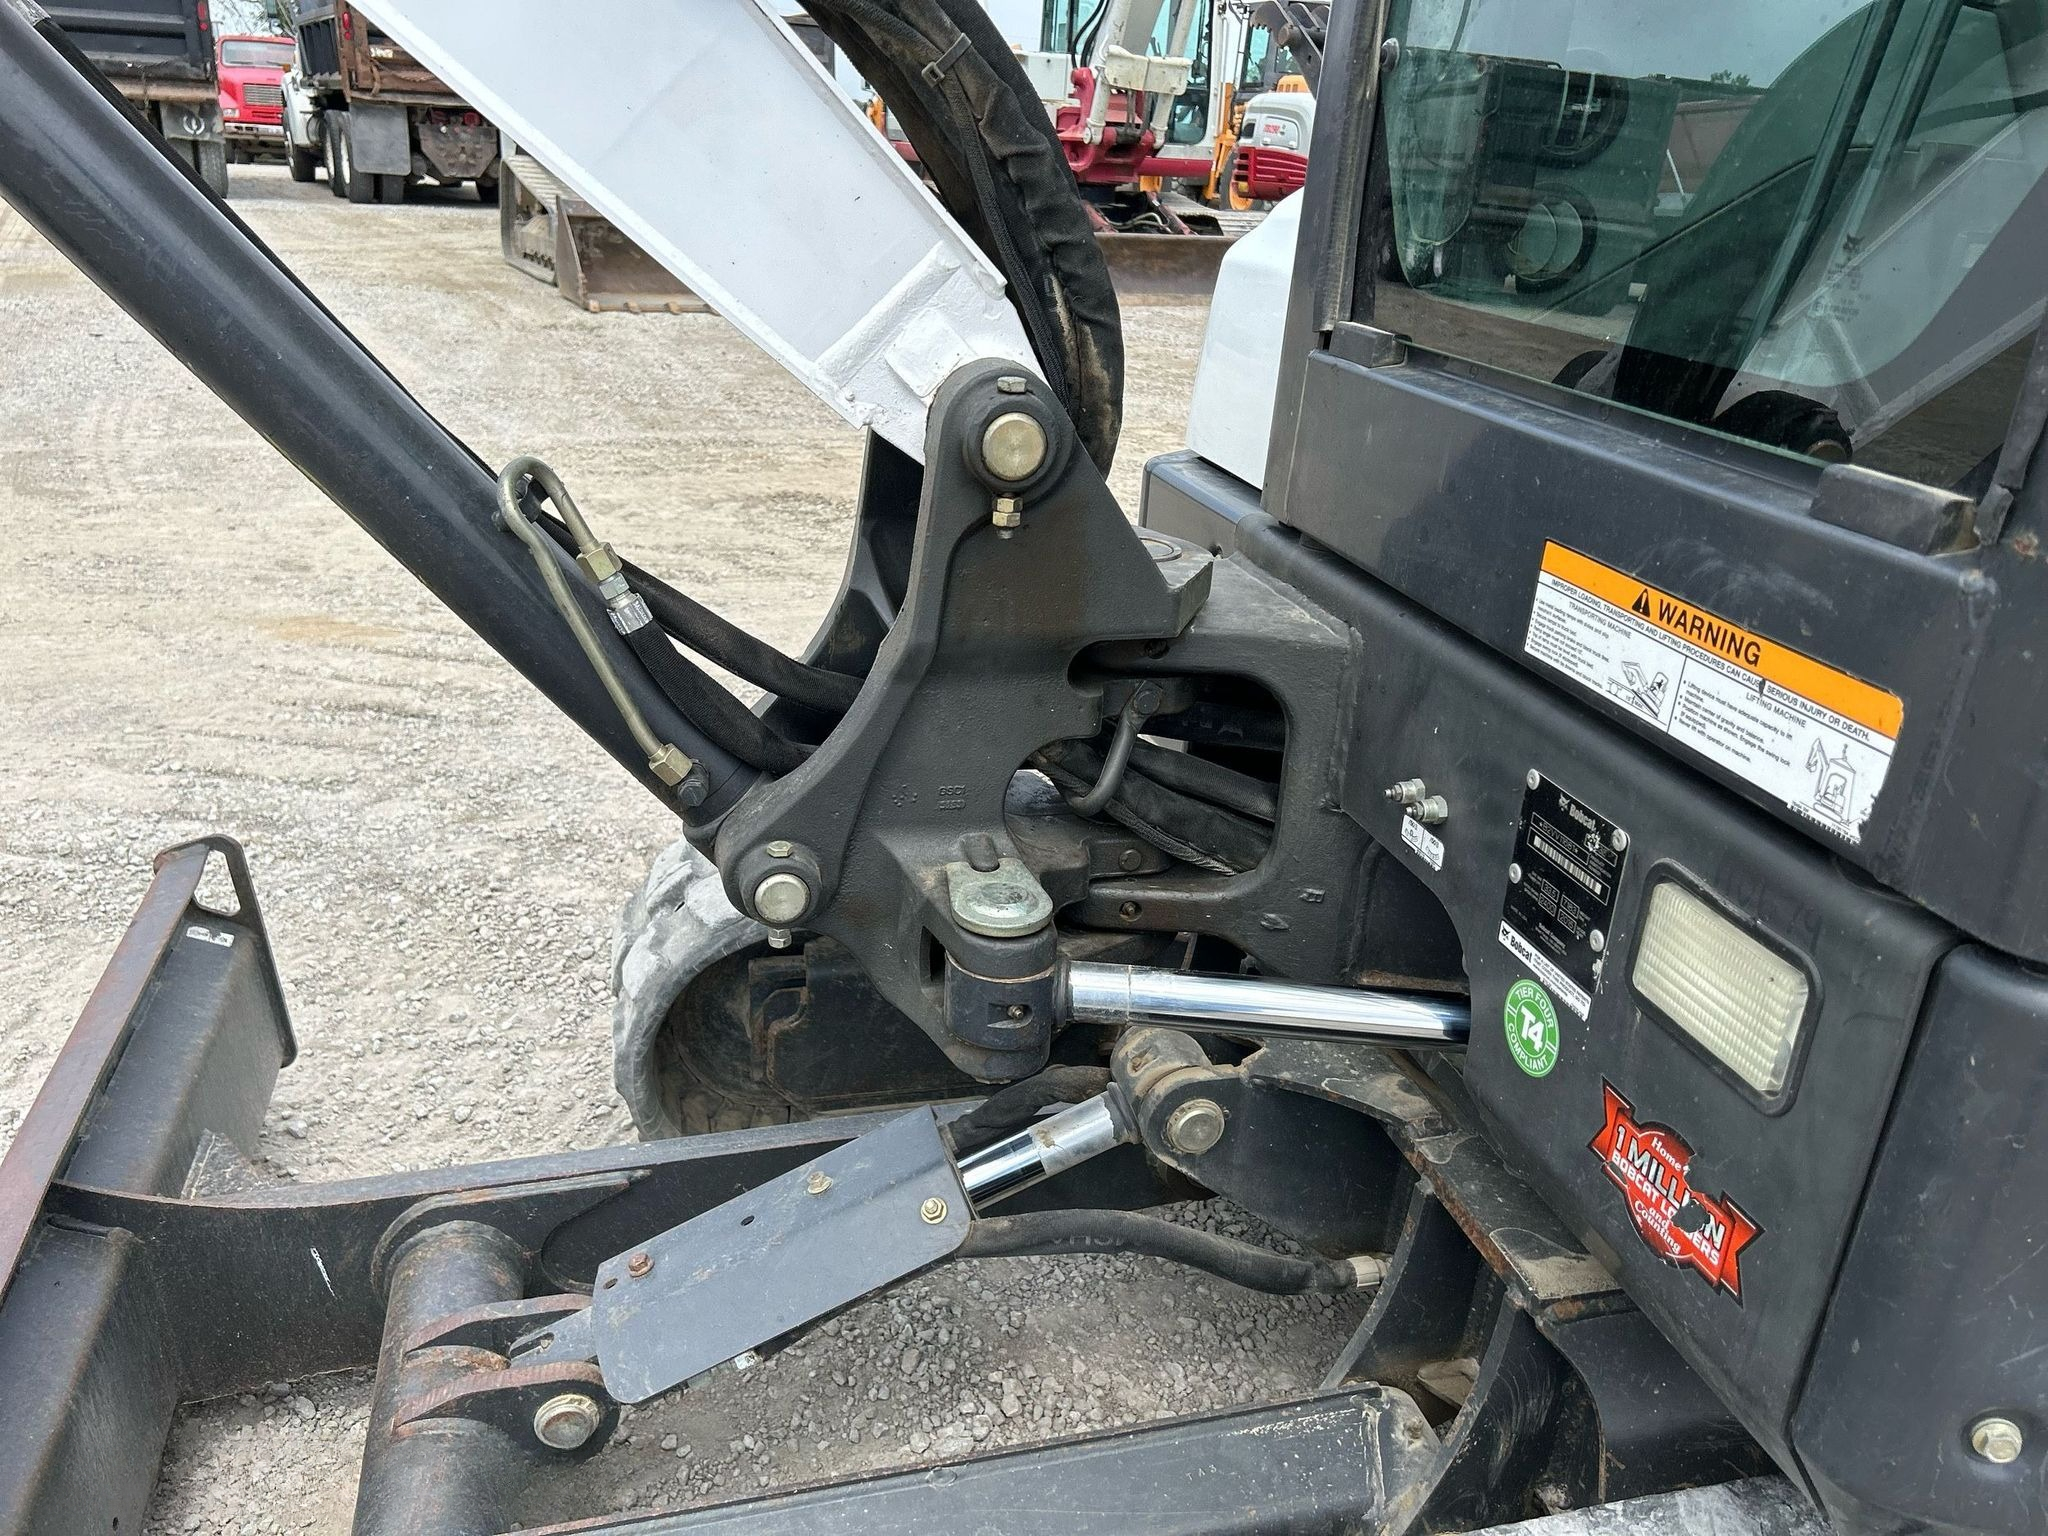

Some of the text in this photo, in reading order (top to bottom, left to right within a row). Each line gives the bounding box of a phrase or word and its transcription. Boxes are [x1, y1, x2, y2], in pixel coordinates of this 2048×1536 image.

[1569, 601, 1631, 639] TRANSPORTING MACHINE
[1658, 598, 1760, 666] WARNING
[1551, 578, 1869, 741] IMPROPER LOADING, TRANSPORTING AND LIFTING PROCEDURES CAN CAUS SERIOUS INJURY OR DEATH.
[1745, 692, 1806, 728] LIFTING MACHINE
[1569, 803, 1595, 831] Bobcat
[1510, 935, 1532, 962] Bobcat
[1515, 987, 1554, 1028] TIER FOUR
[1521, 1005, 1545, 1053] T4
[1508, 1023, 1549, 1071] COMPLIANT
[1650, 1136, 1682, 1171] Home
[1612, 1149, 1720, 1266] BOBCAT LOERS
[1615, 1125, 1726, 1251] 1 MILLIN
[1635, 1200, 1681, 1254] Counting
[1649, 1207, 1671, 1229] and
